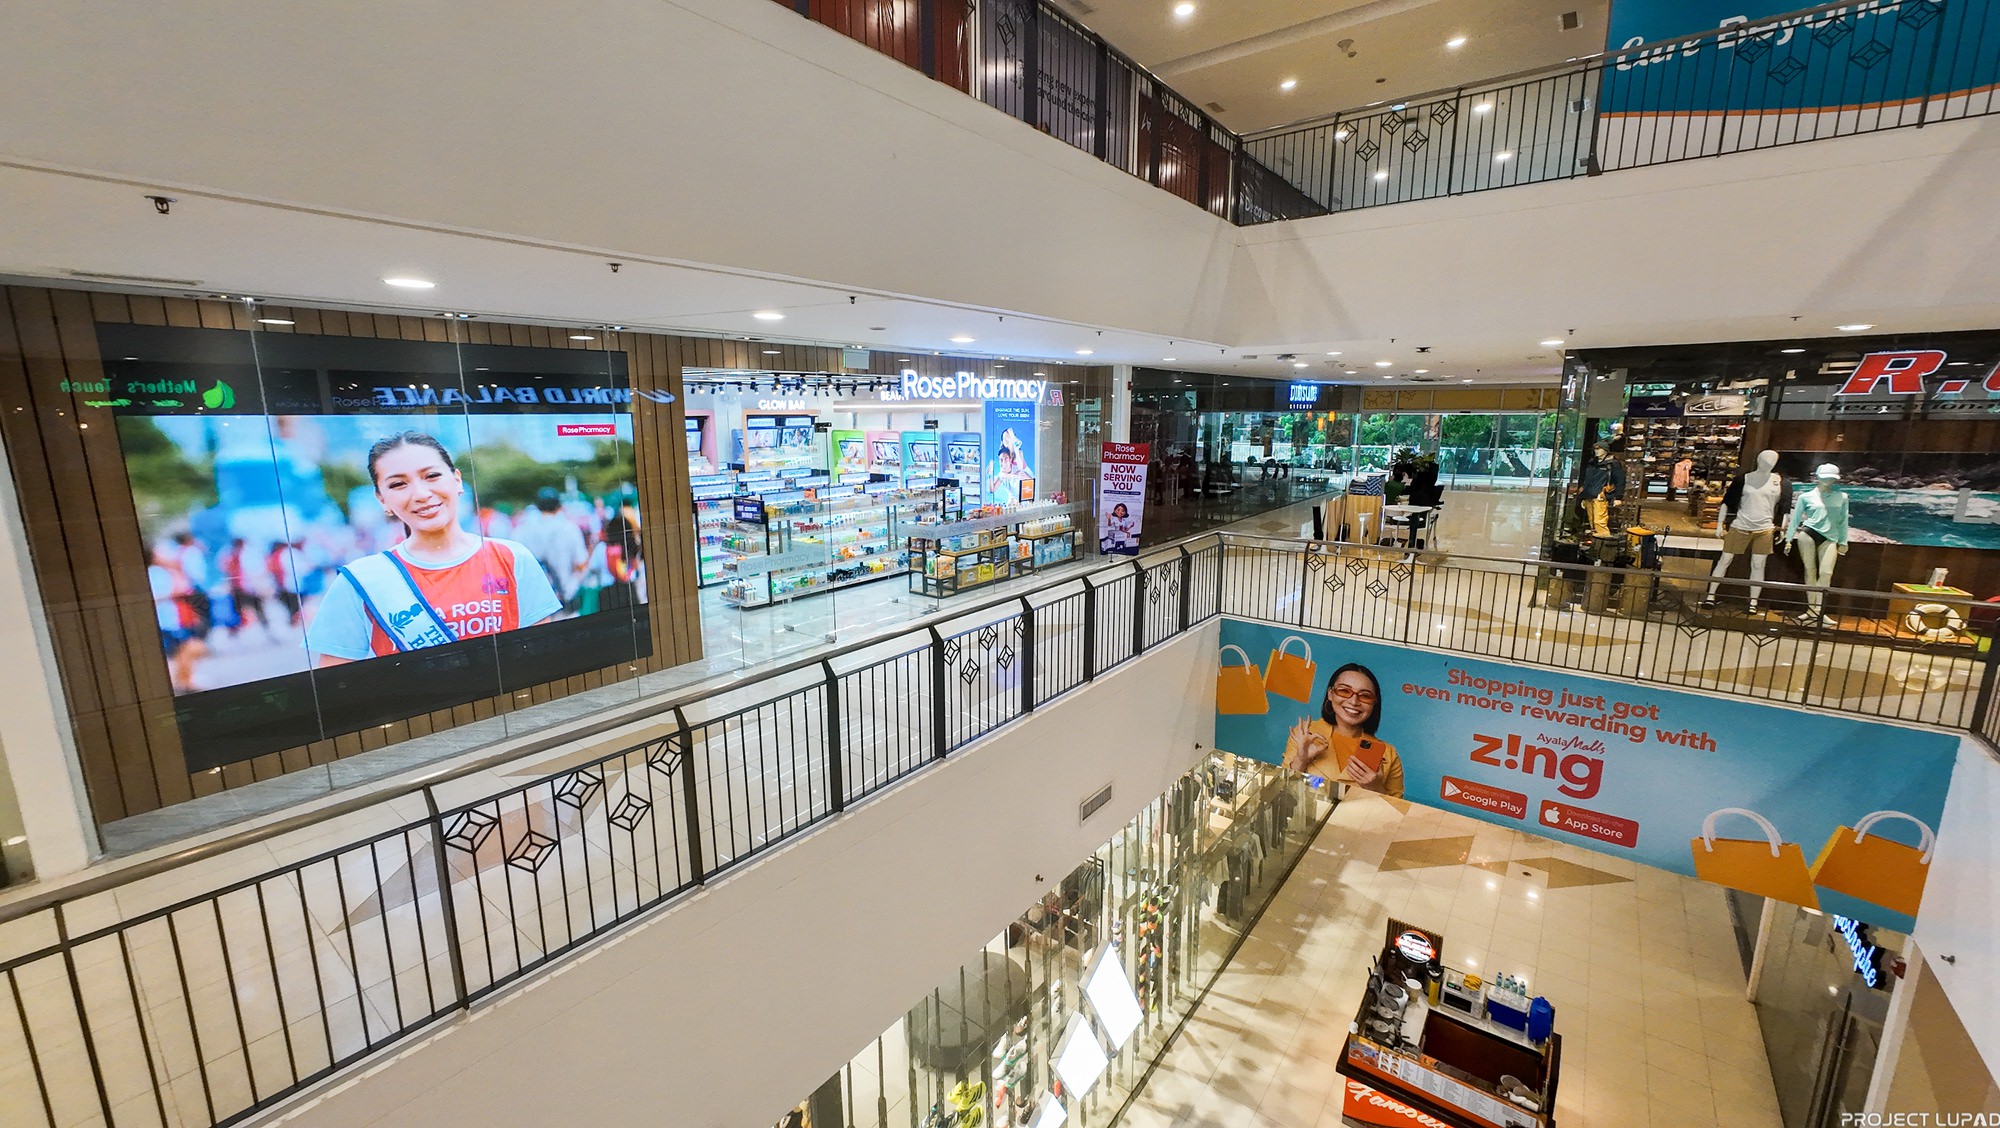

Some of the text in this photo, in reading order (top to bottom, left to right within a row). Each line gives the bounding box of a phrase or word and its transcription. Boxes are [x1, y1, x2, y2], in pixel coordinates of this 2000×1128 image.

[758, 399, 806, 410] GLOW BAR
[1115, 443, 1135, 453] Rose
[1103, 451, 1146, 462] Pharmacy
[1110, 464, 1137, 474] NOW
[1103, 473, 1143, 483] SERVING
[1112, 482, 1134, 491] YOU
[451, 599, 502, 618] ROSE
[449, 615, 503, 639] RIOR!
[1447, 668, 1660, 721] Shopping just got
[1401, 683, 1717, 753] even more rewarding with
[1536, 733, 1567, 747] Ayala
[1462, 791, 1523, 815] Google Play
[1564, 817, 1624, 839] App Store
